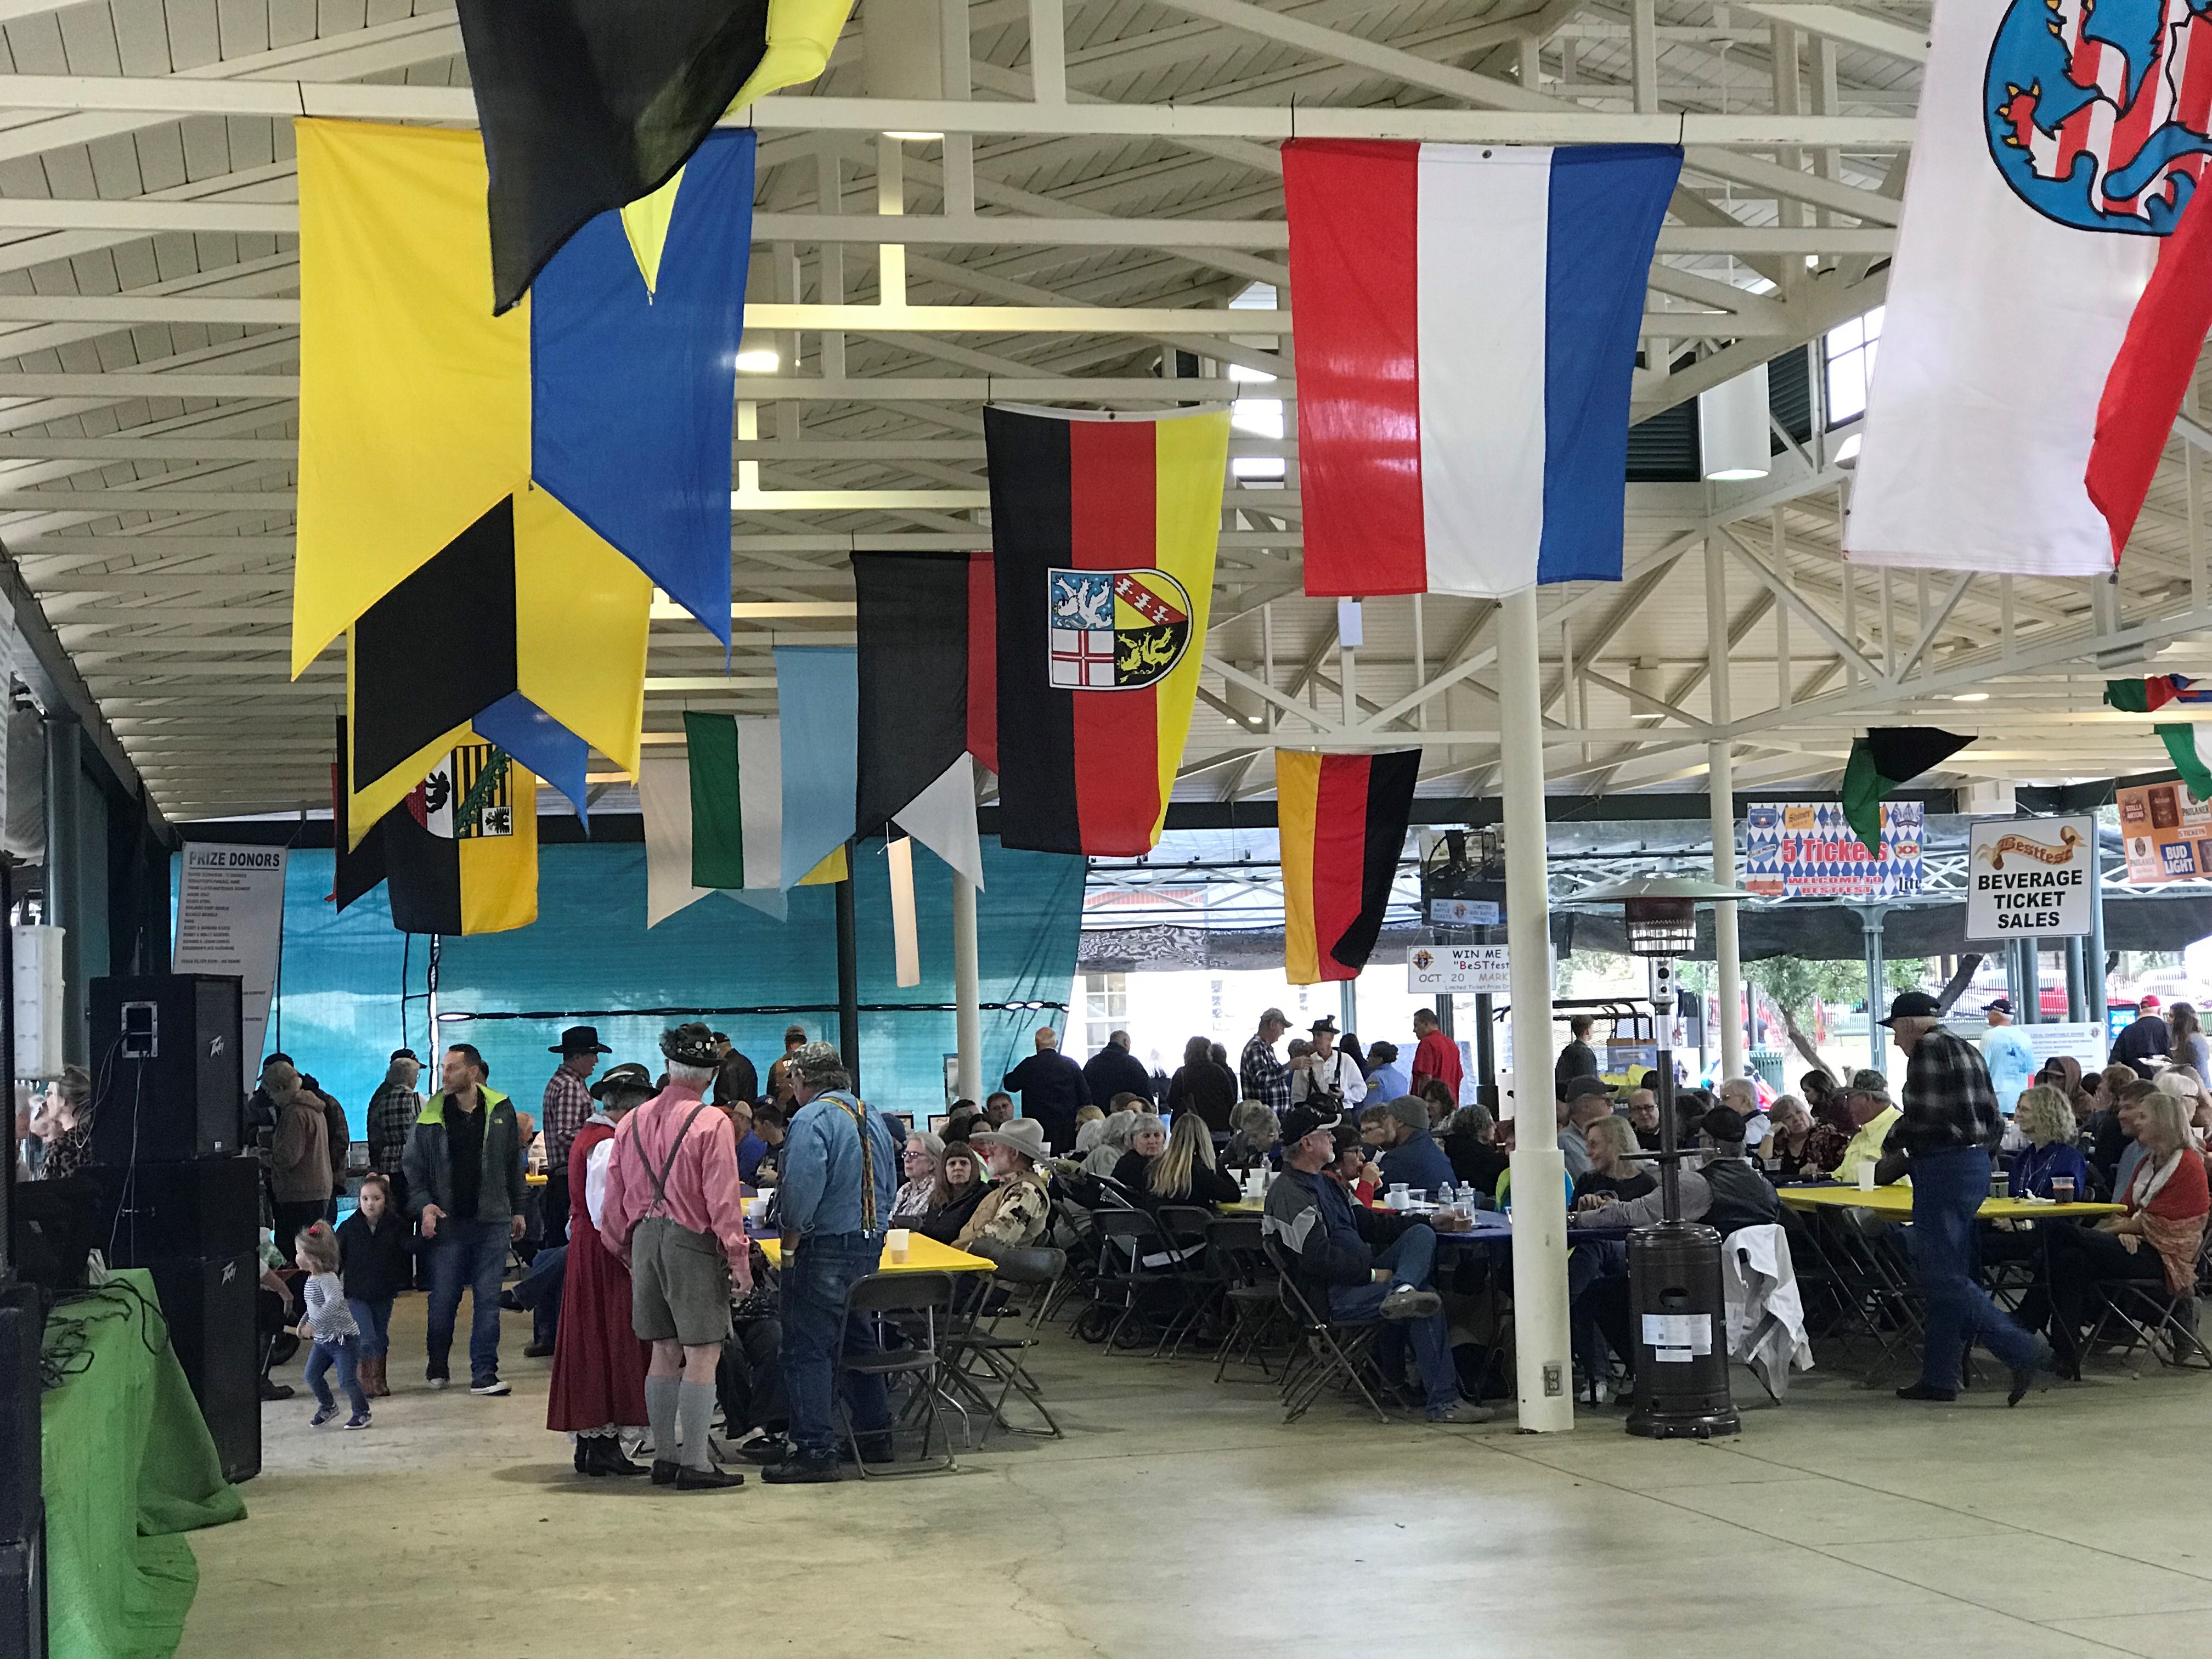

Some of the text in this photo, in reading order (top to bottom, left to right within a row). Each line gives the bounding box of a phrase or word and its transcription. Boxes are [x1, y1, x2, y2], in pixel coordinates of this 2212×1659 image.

[1788, 810, 1811, 823] Shiner
[1782, 839, 1796, 862] 5
[1997, 837, 2073, 864] Bestfest
[2165, 845, 2187, 860] BUD
[189, 851, 280, 867] PRIZE DONORS
[2164, 858, 2194, 874] LIGHT
[1978, 870, 2082, 890] BEVERAGE
[1994, 891, 2066, 909] TICKET
[1997, 912, 2059, 929] SALES
[1453, 950, 1479, 958] WIN
[1485, 950, 1501, 958] ME
[1451, 973, 1464, 981] 20
[1479, 973, 1509, 981] MARK
